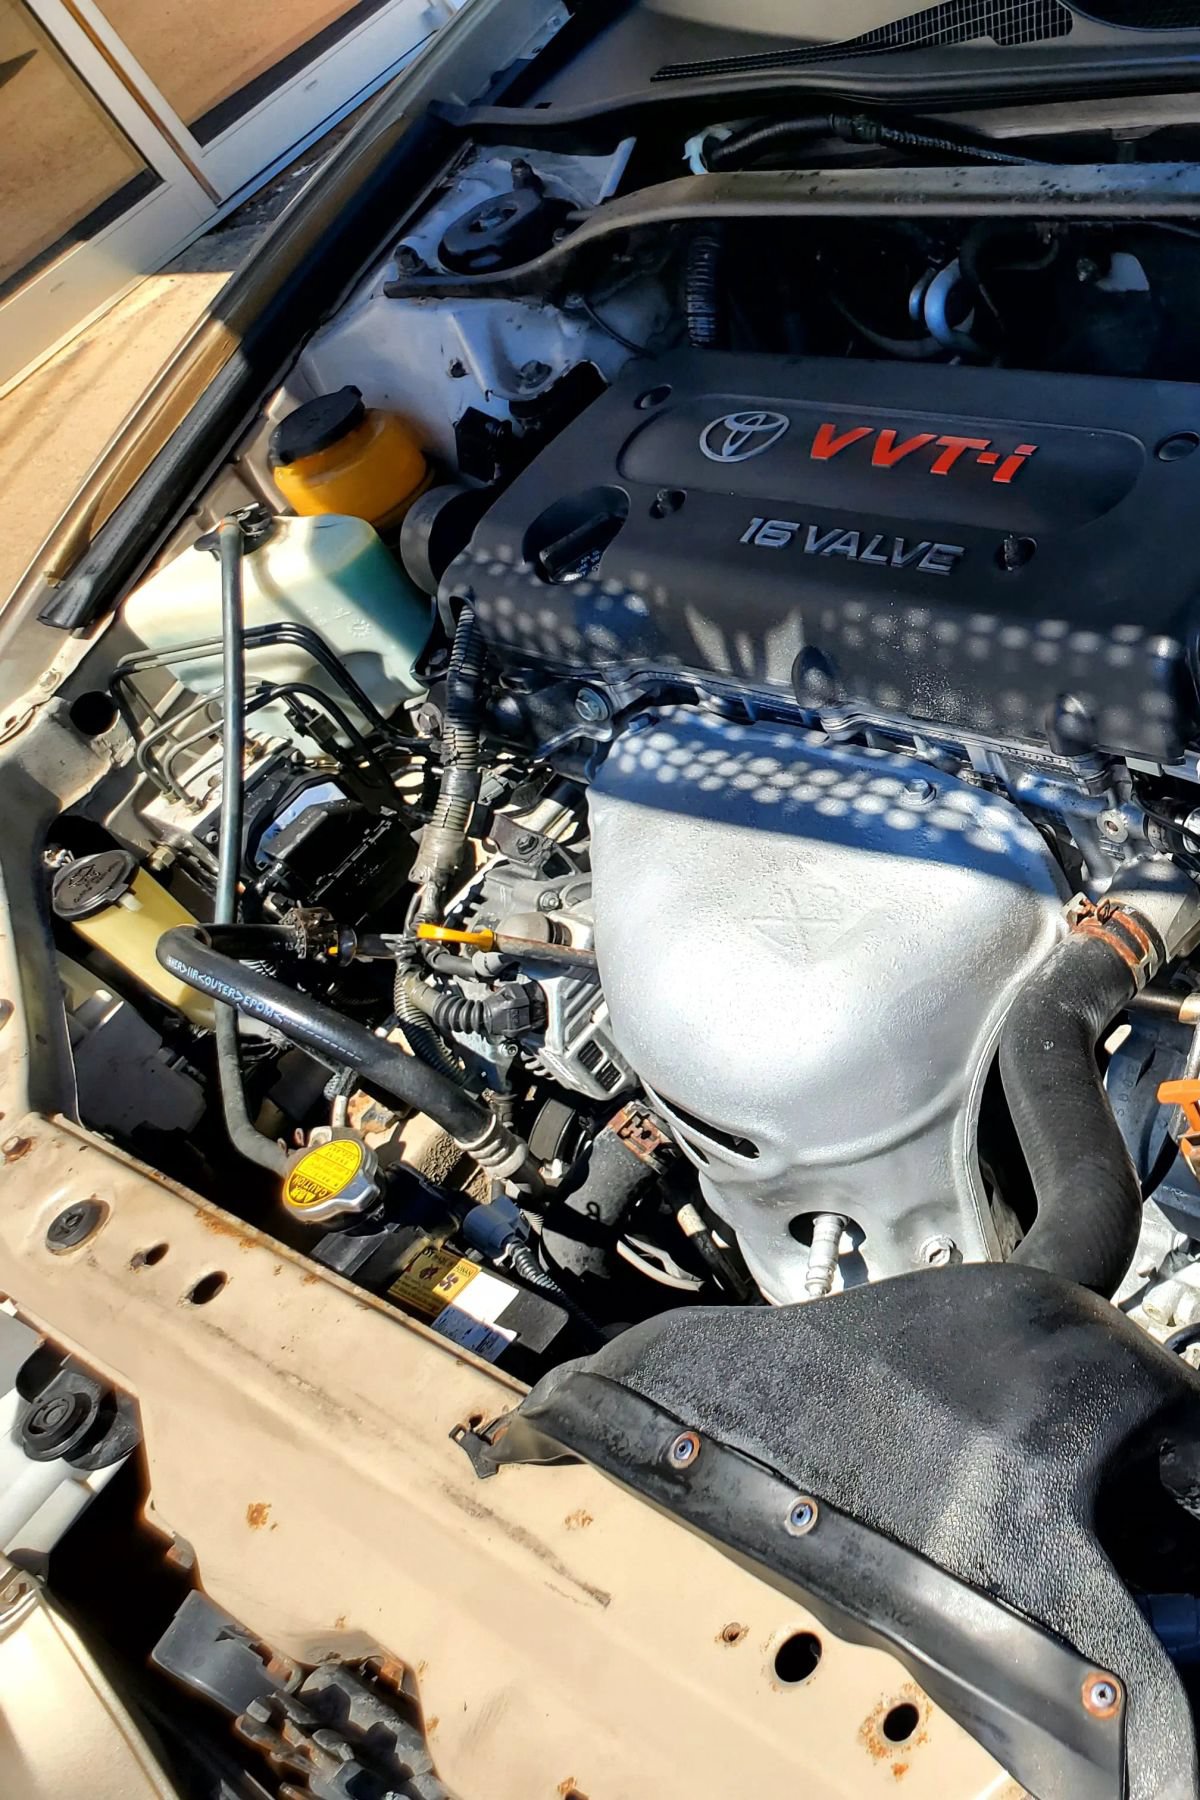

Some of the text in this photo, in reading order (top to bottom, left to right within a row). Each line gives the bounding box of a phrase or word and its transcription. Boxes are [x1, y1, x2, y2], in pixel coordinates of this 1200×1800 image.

[808, 422, 1039, 484] VVT-i
[739, 516, 965, 576] 16 VALVE
[292, 1176, 328, 1197] CAUTION
